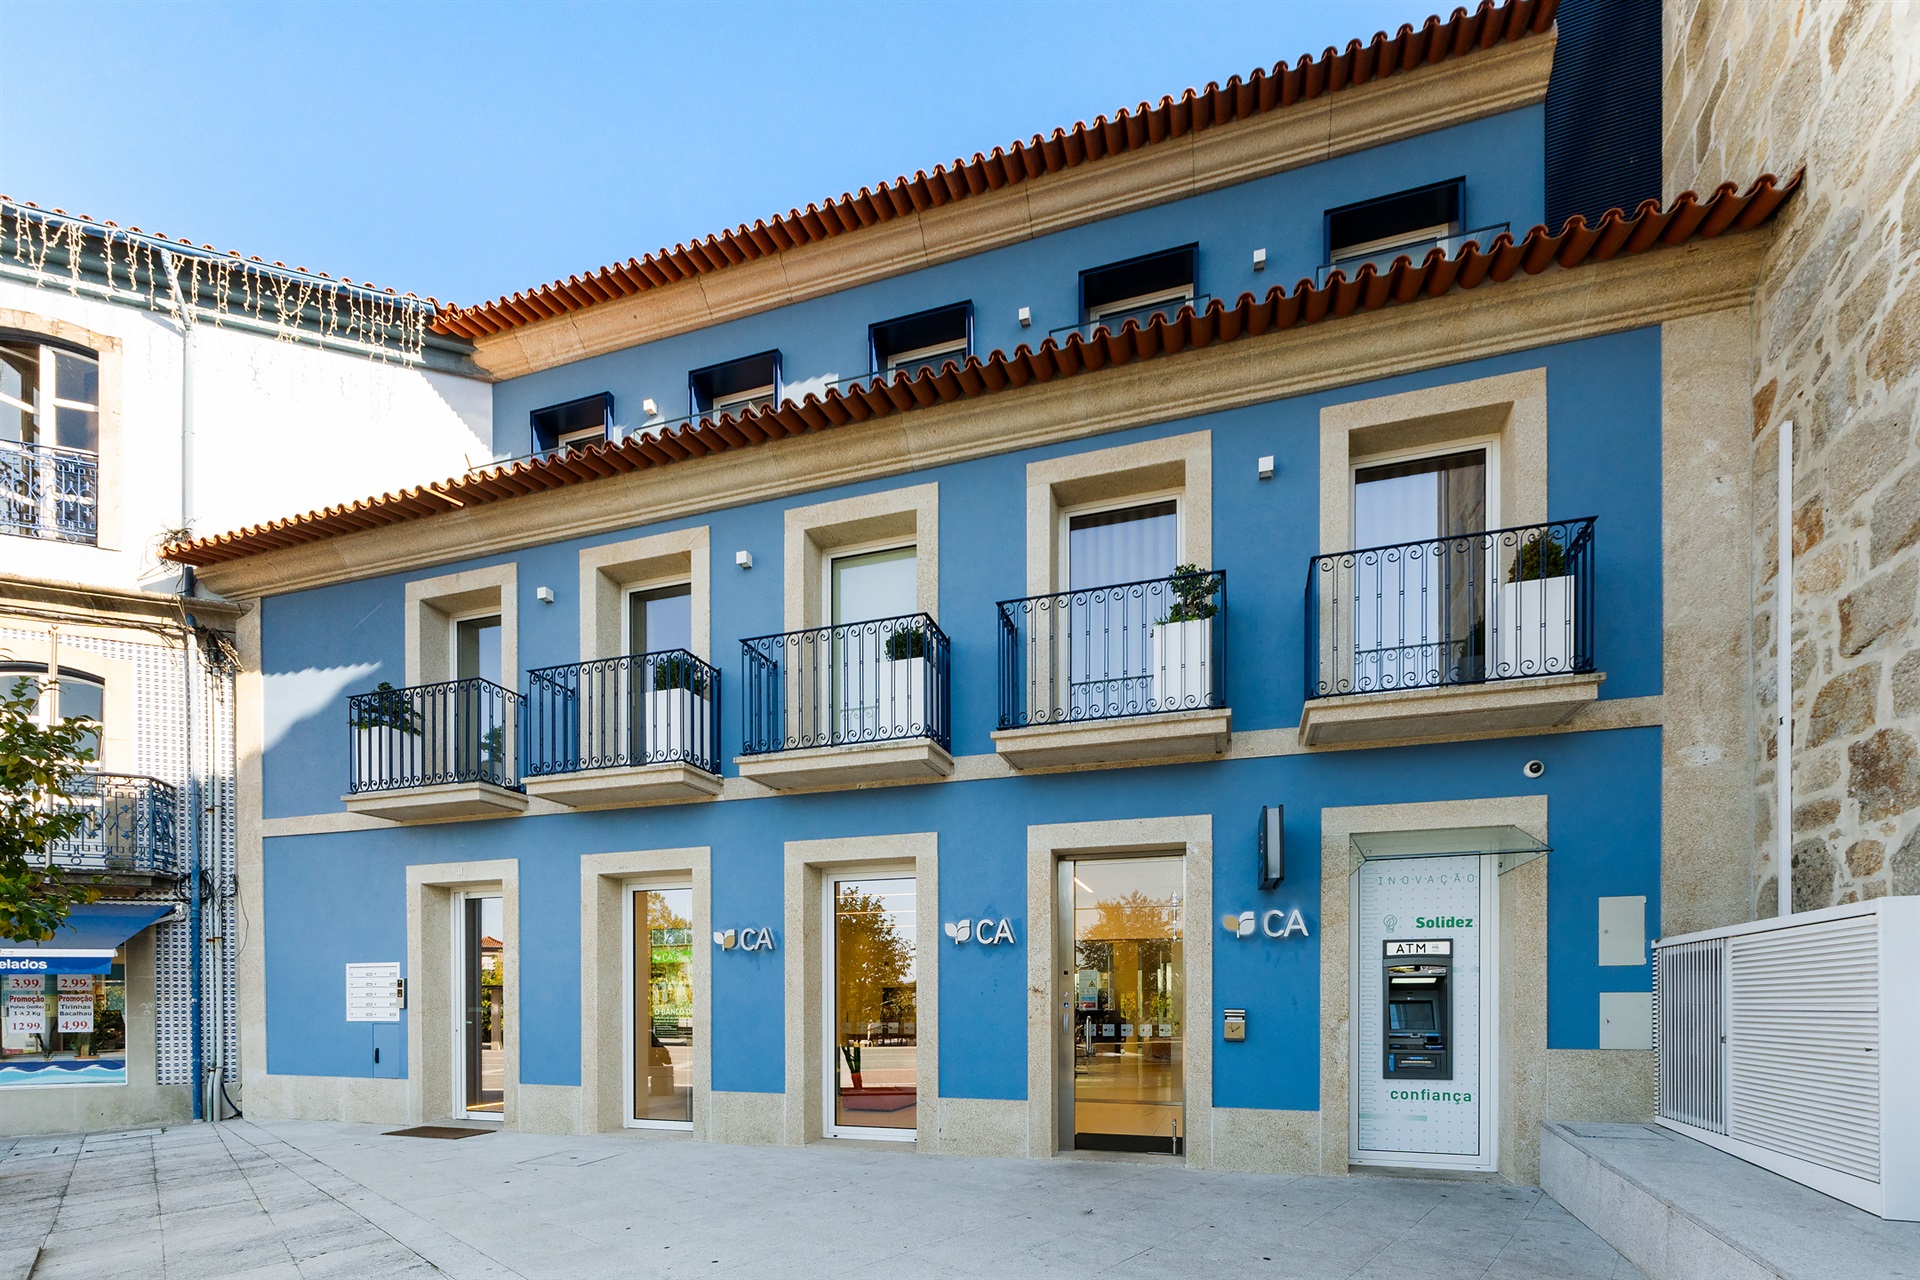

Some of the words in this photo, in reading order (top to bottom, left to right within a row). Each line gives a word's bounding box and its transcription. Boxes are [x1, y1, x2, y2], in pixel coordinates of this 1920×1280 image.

[1378, 873, 1475, 885] INOVAÇÃO
[1263, 909, 1309, 938] CA
[1415, 916, 1473, 928] Solidez
[976, 919, 1015, 945] CA
[740, 927, 774, 951] CA
[1395, 943, 1426, 954] ATM
[9, 995, 45, 1005] Promoção
[58, 995, 93, 1005] Promoção
[654, 1008, 660, 1016] O
[661, 1008, 684, 1016] BANCO
[1390, 1088, 1472, 1104] confiança
